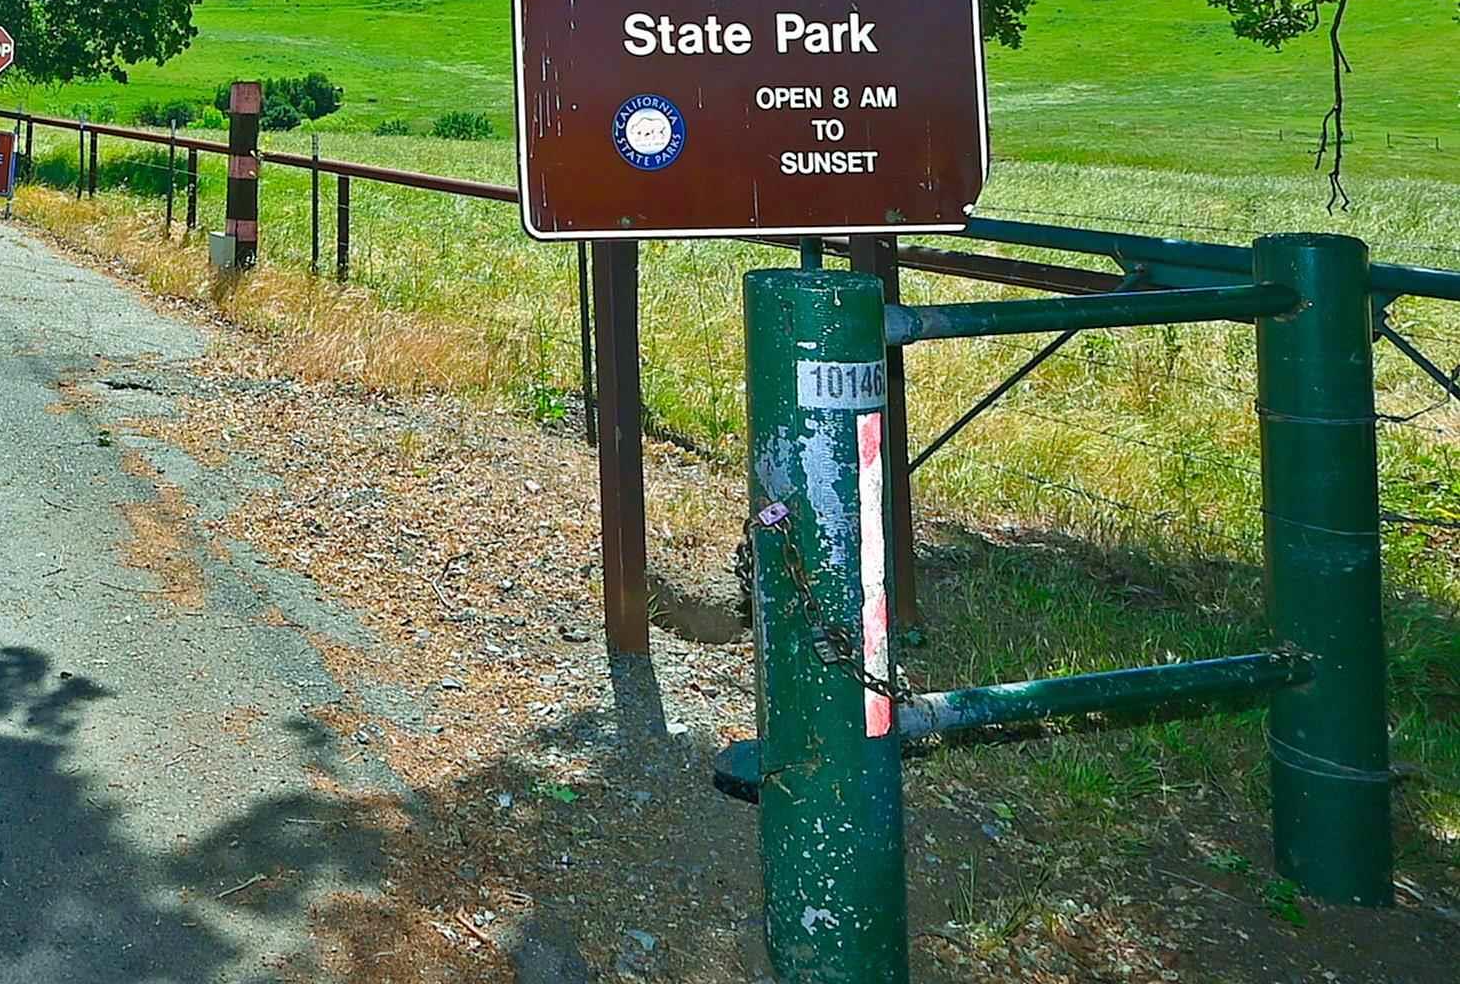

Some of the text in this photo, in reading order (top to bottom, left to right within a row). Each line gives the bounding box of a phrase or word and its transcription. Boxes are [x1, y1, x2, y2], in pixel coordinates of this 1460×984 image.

[623, 13, 879, 56] State Park
[615, 96, 679, 130] CALIFORNIA
[755, 87, 897, 109] OPEN 8 AM
[811, 119, 845, 142] TO
[616, 133, 682, 167] STATE PARKS
[780, 151, 878, 174] SUNSET
[809, 364, 886, 398] 10146
